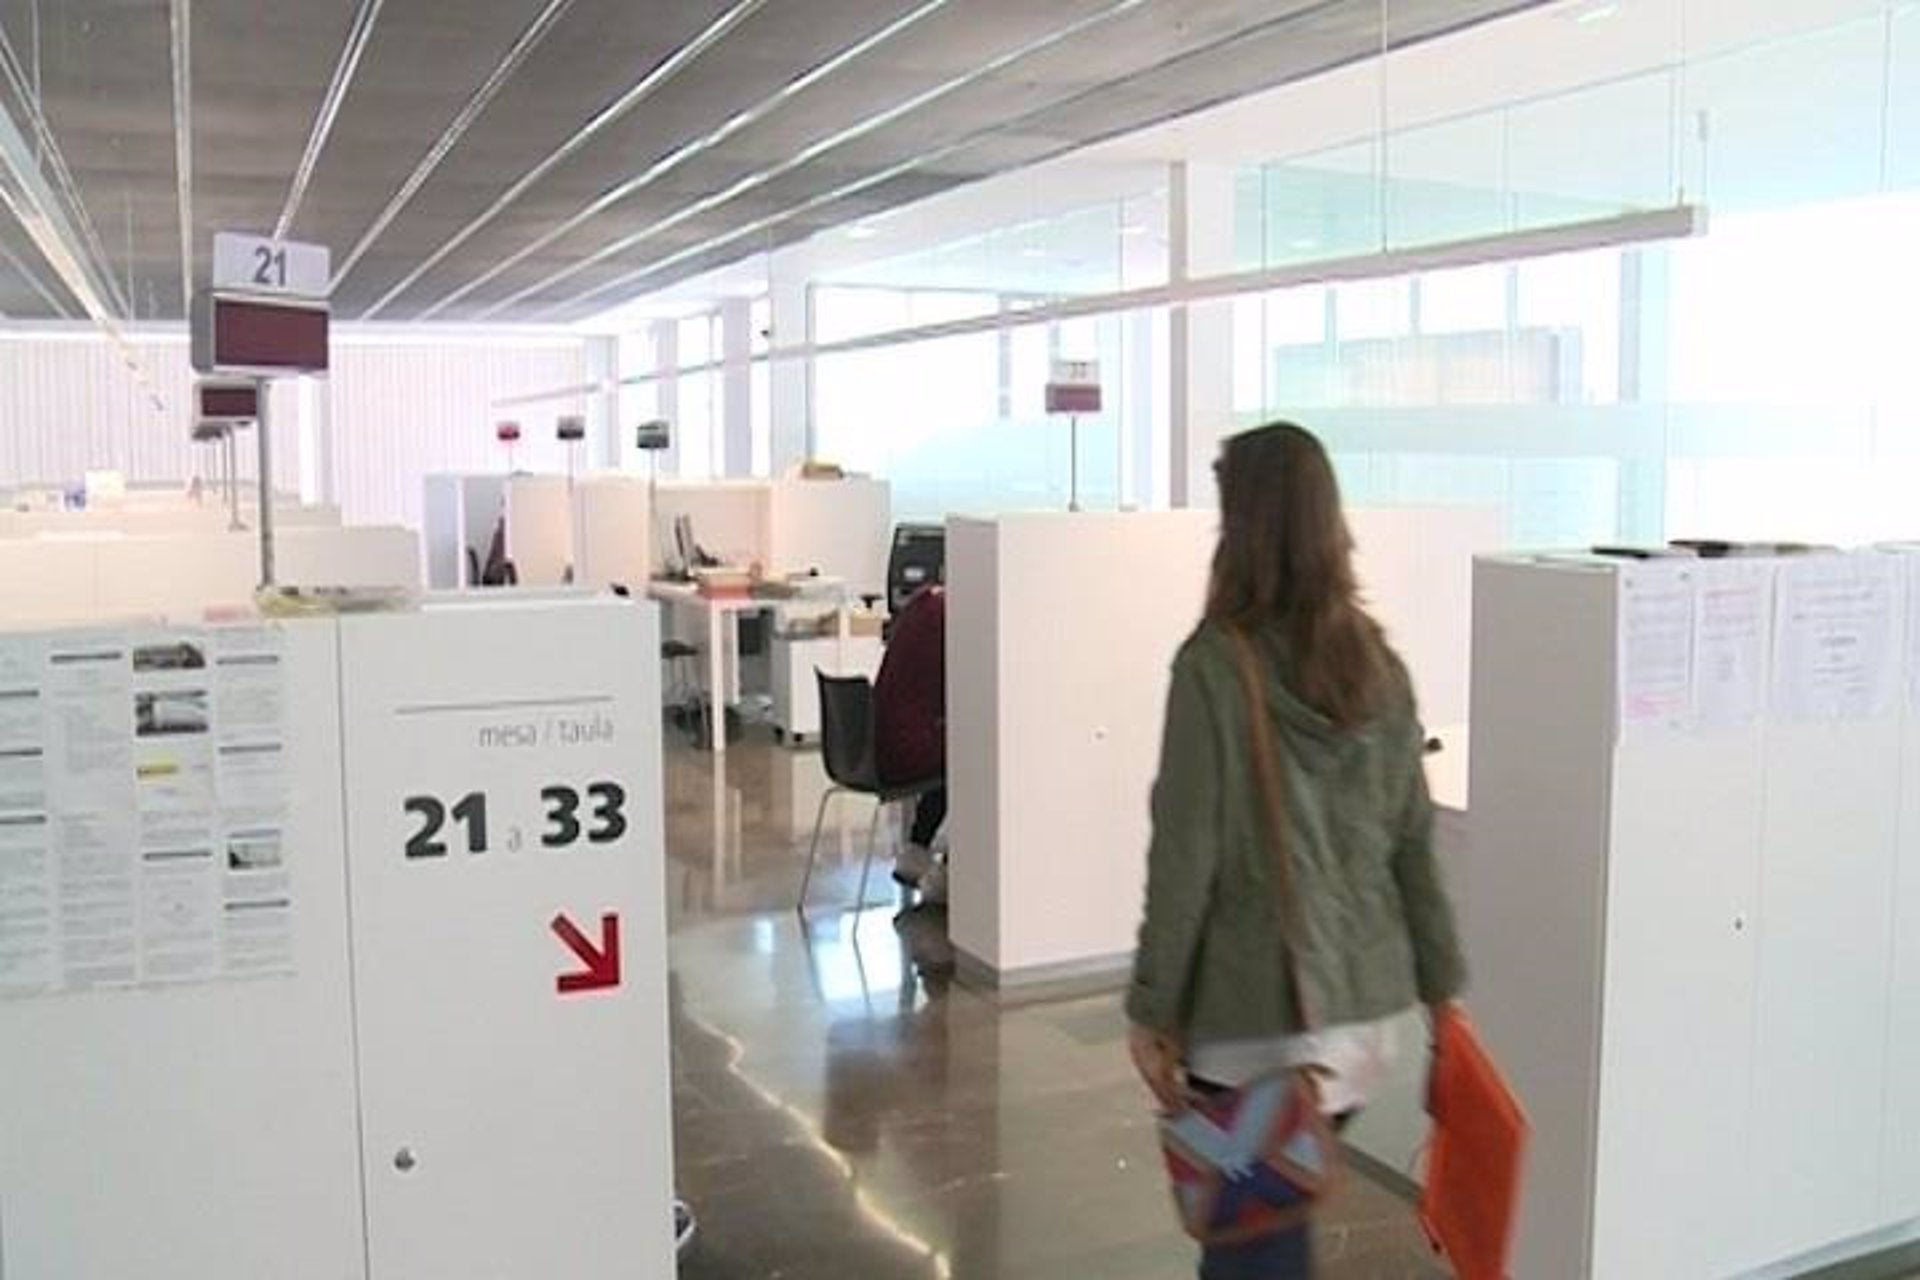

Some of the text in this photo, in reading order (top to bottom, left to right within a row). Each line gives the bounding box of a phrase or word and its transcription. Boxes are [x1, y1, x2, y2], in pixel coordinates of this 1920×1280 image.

[255, 245, 286, 287] 21
[478, 723, 538, 747] mesa
[557, 712, 615, 743] taula
[403, 791, 488, 859] 21
[540, 781, 628, 848] 33
